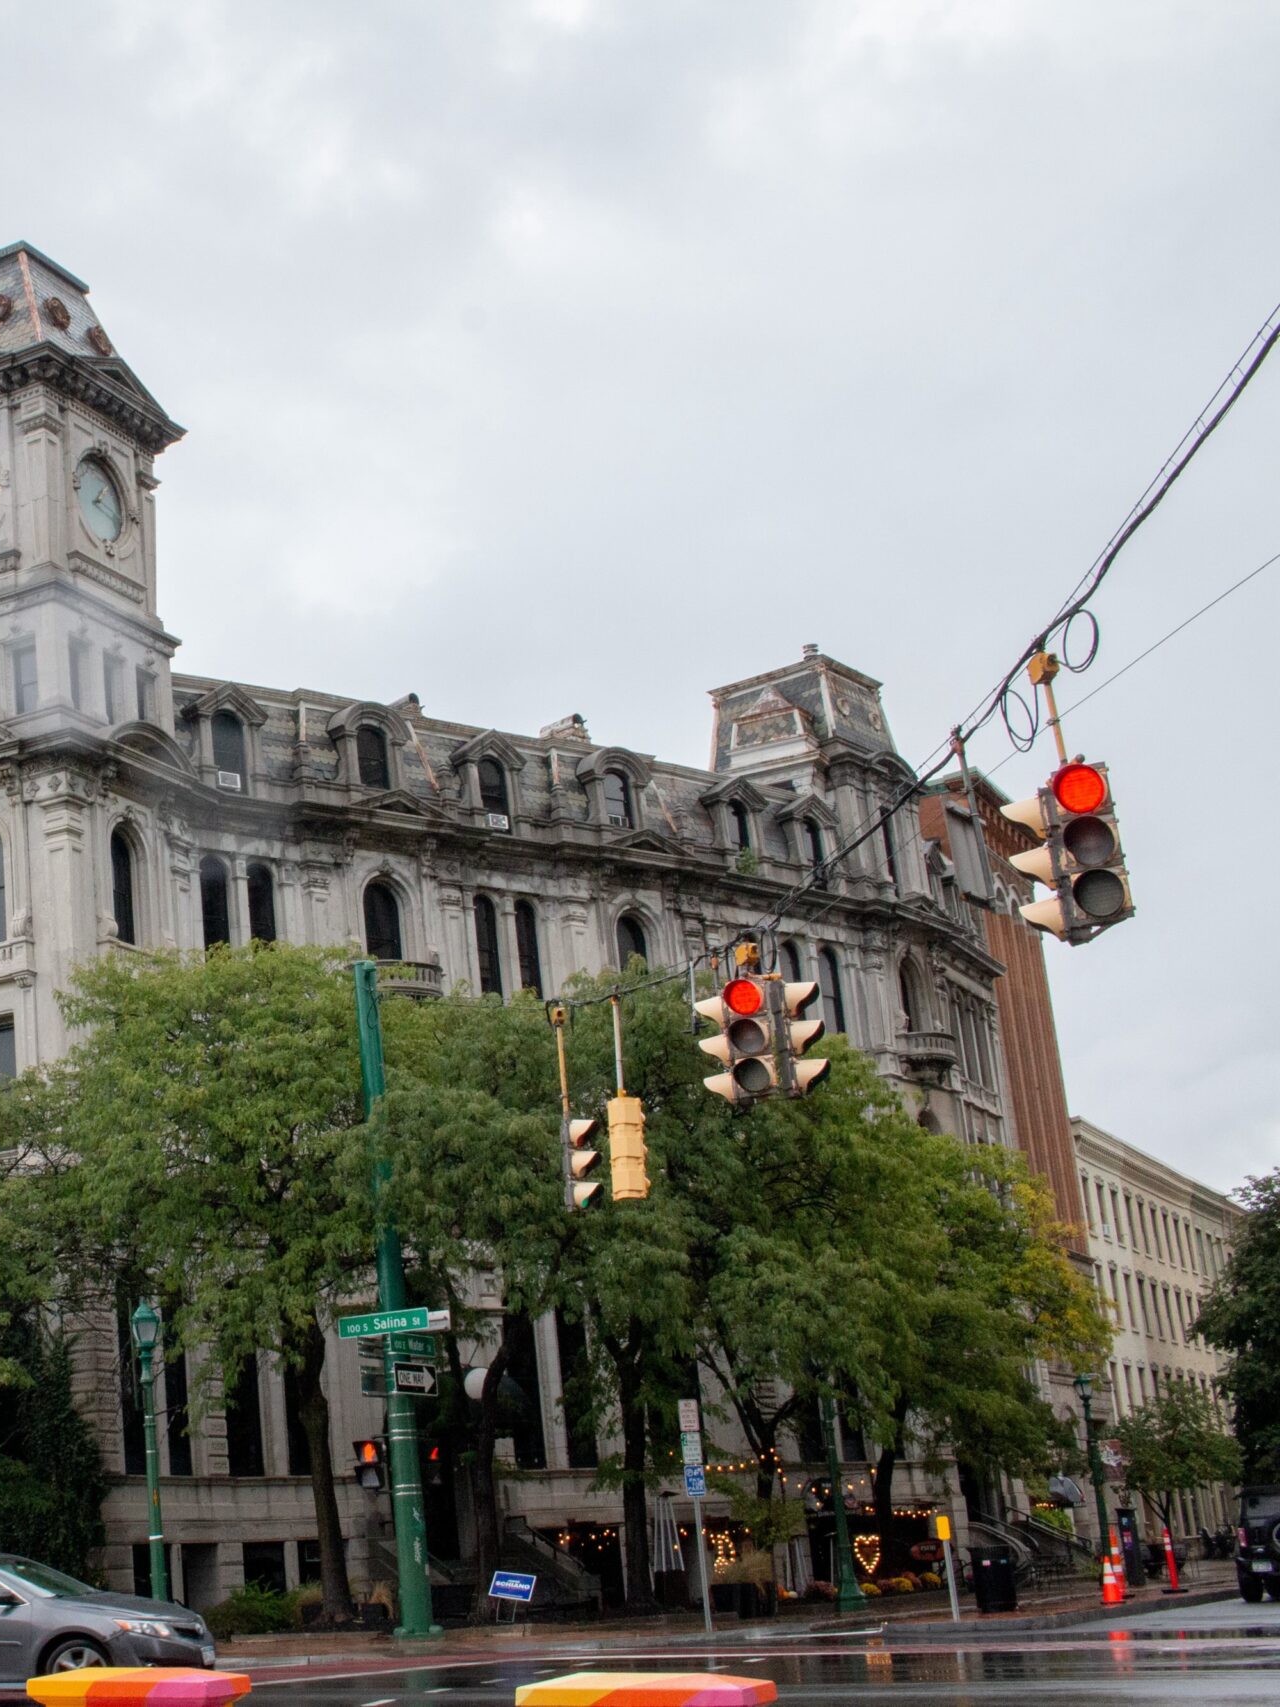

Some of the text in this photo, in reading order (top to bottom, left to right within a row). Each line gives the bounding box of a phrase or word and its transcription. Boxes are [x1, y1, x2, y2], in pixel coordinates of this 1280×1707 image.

[347, 1325, 361, 1333] 100
[363, 1323, 368, 1332] S
[373, 1317, 408, 1330] Salina
[400, 1372, 425, 1385] ONE WAY
